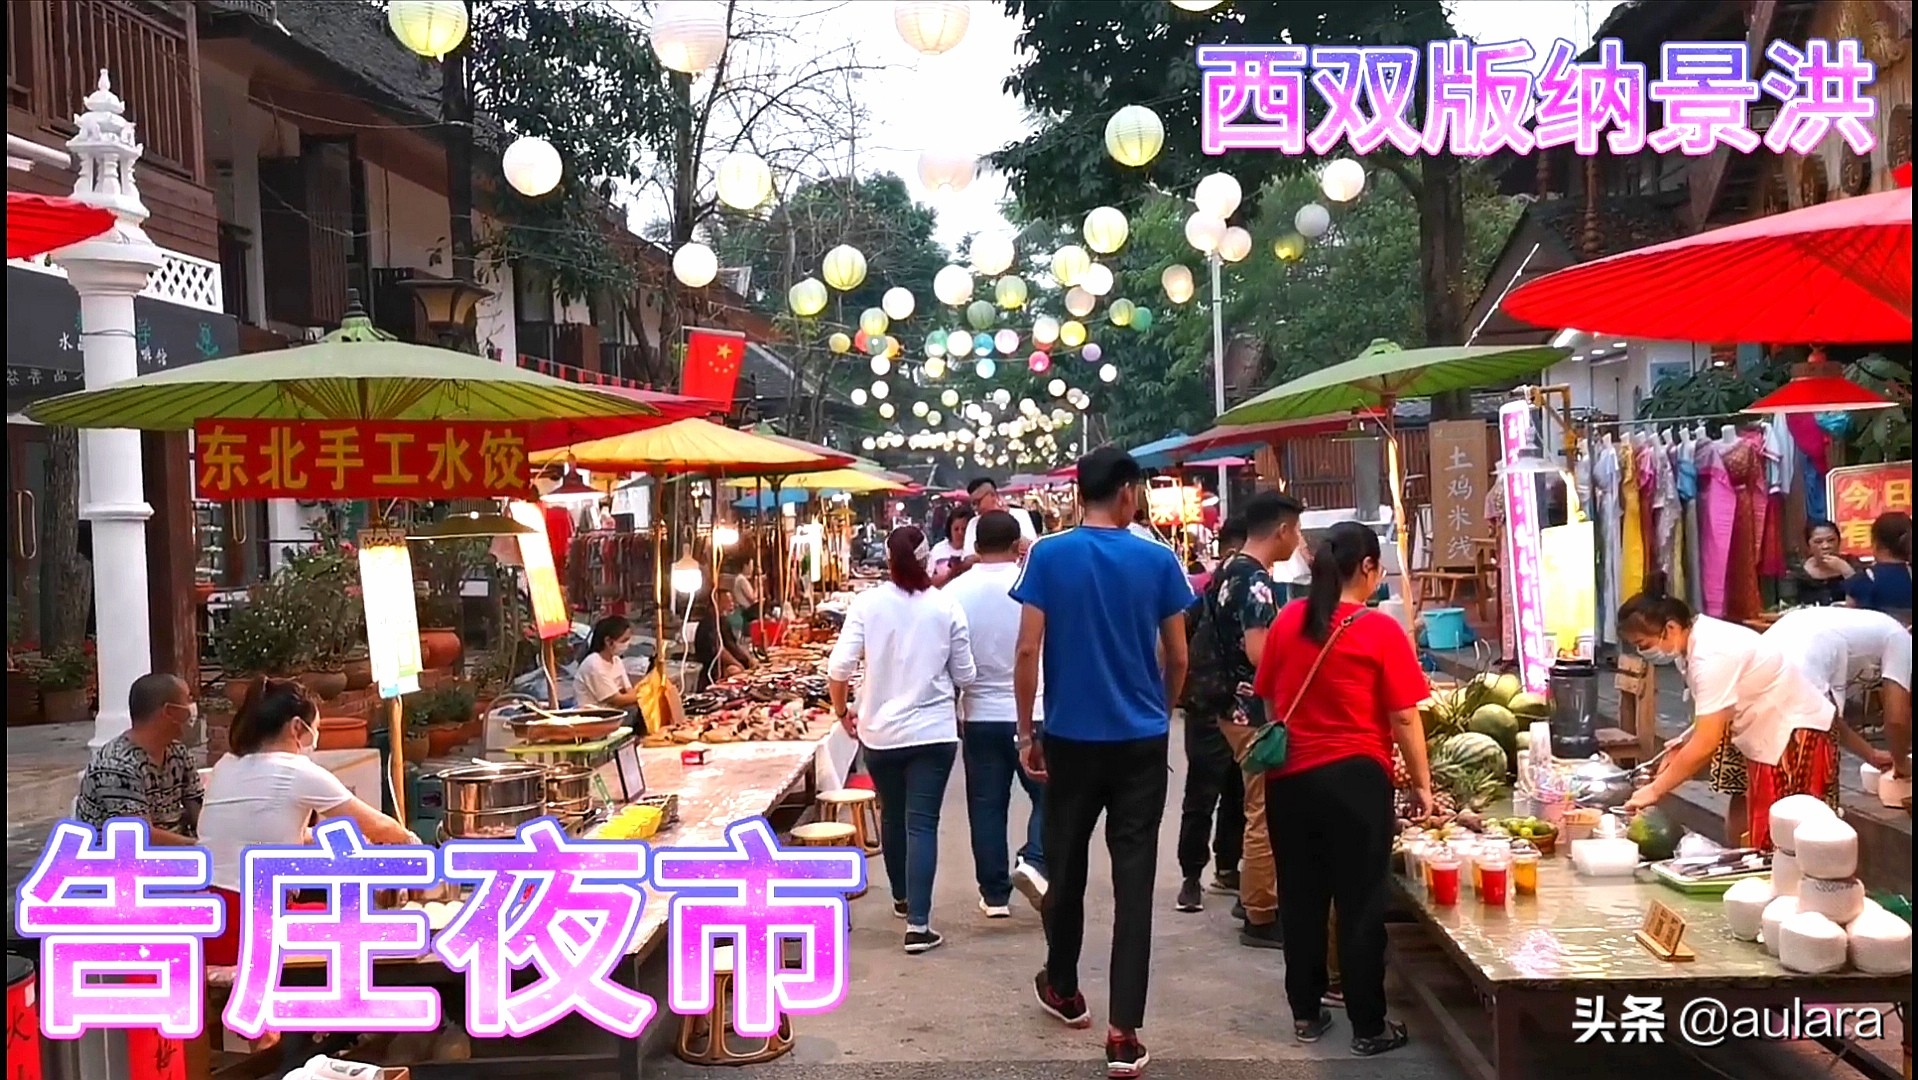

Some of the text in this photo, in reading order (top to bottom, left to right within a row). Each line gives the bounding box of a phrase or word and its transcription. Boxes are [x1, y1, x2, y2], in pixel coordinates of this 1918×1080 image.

[198, 425, 526, 491] 东北手工水饺
[1444, 445, 1474, 560] 土鸡米线
[1839, 479, 1911, 511] 今日
